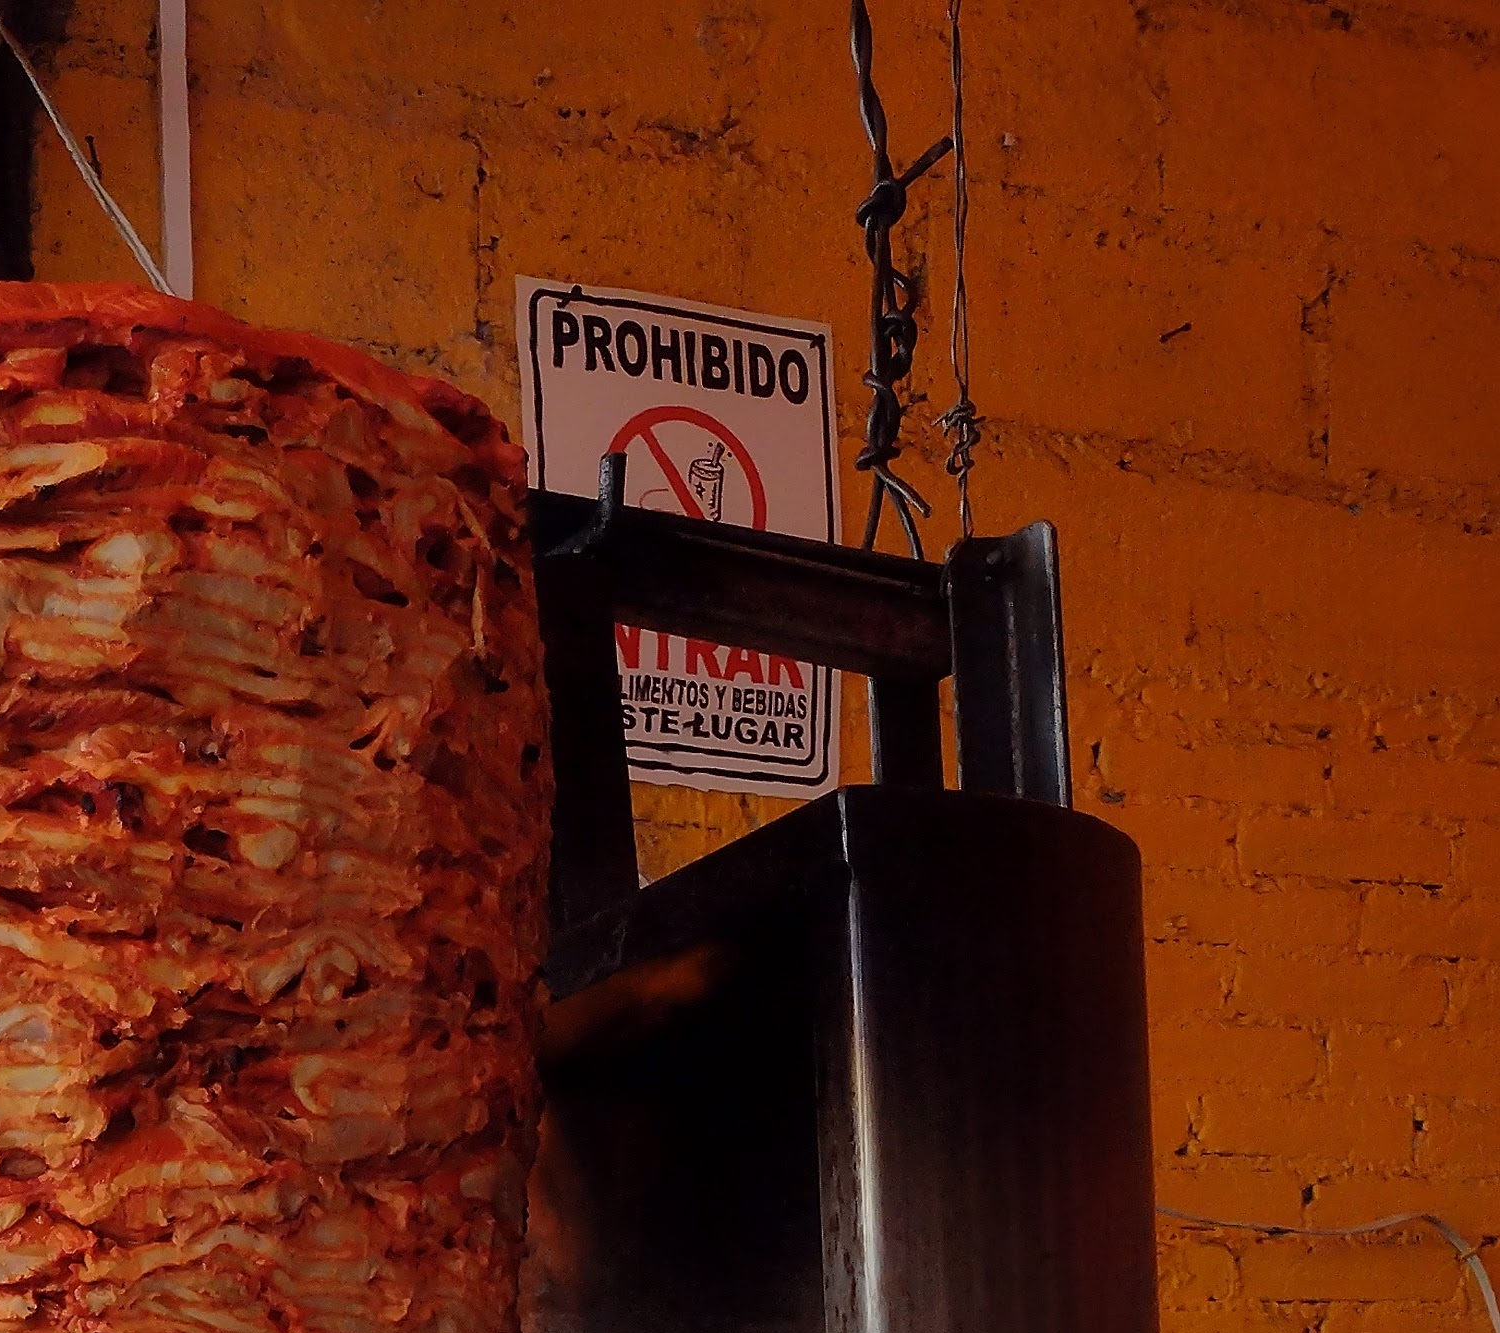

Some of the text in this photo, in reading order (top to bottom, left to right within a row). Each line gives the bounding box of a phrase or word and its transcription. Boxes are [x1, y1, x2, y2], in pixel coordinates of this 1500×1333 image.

[553, 310, 809, 404] PROHIBIDO
[615, 622, 804, 689] NTRAR
[619, 674, 807, 719] LIMENTOS Y BEBIDAS
[621, 704, 805, 749] STE LUGAR
